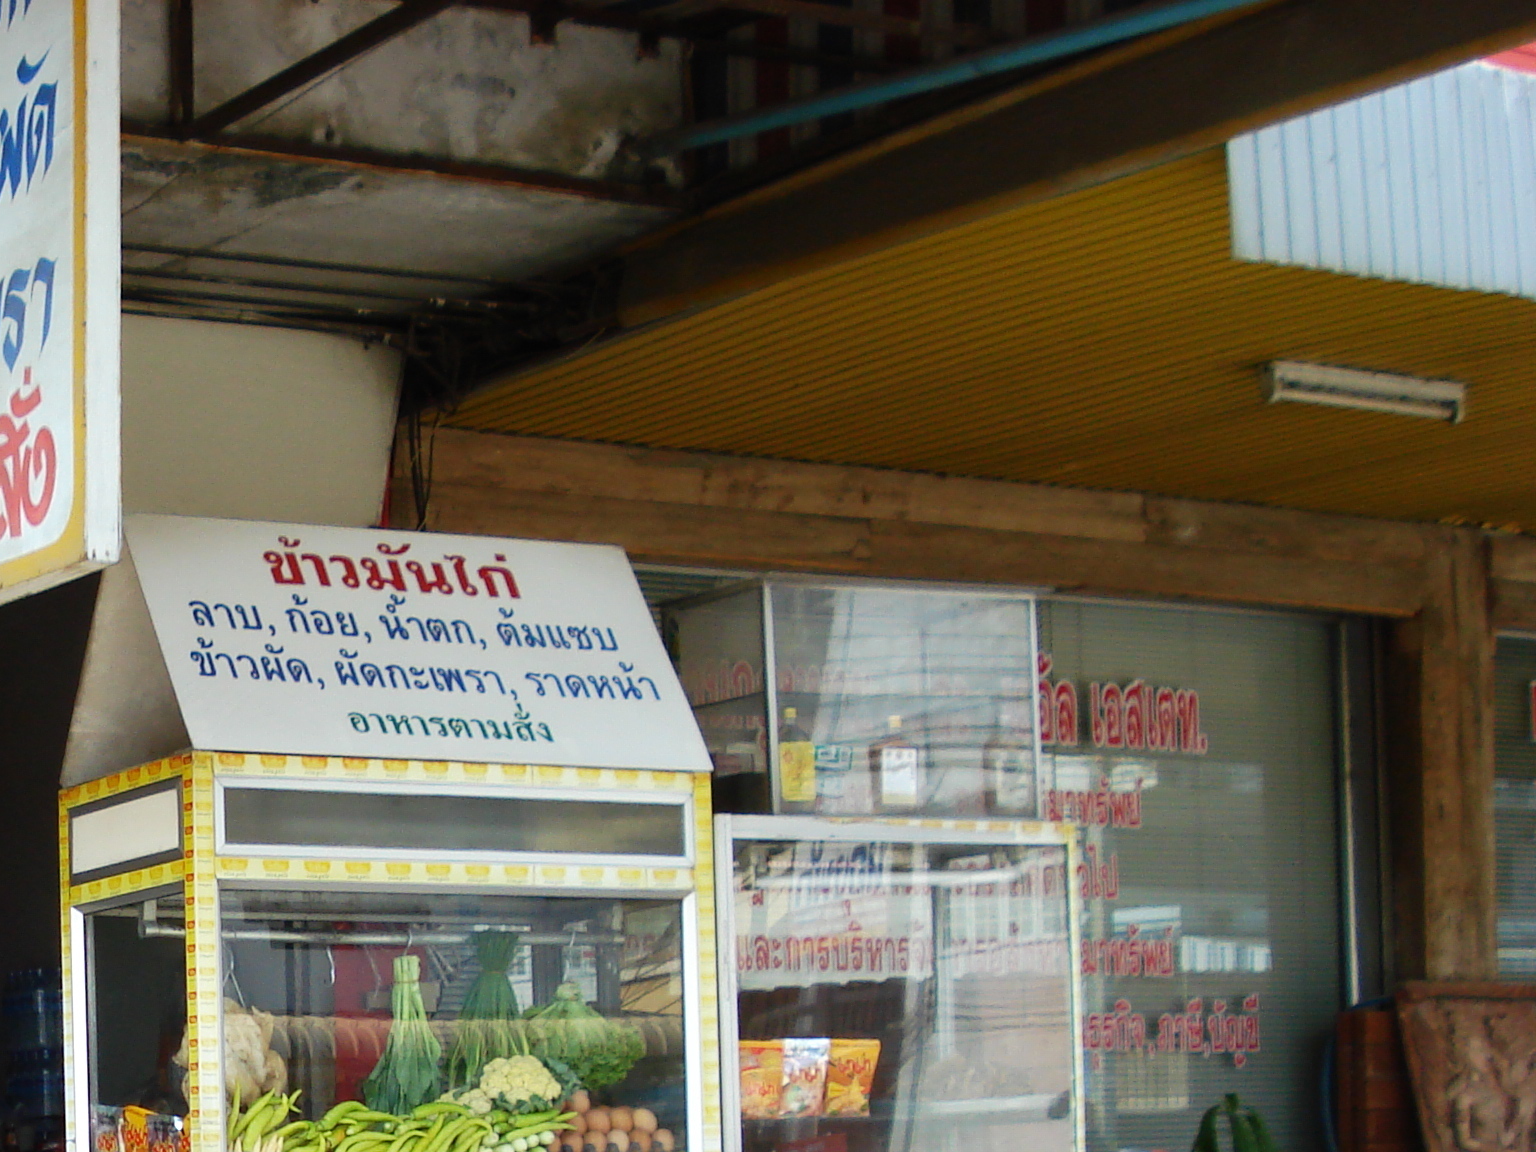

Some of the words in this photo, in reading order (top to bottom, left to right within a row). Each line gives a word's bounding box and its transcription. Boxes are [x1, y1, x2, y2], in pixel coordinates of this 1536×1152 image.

[263, 536, 521, 599] ข้าวมันไก่
[189, 599, 276, 637] ลาบ,
[285, 600, 371, 643] ก้อย,
[380, 594, 487, 650] น้ำตก,
[497, 606, 619, 653] ต้มแซบ
[190, 637, 324, 690] ข้าวผัด,
[335, 648, 519, 699] ผัดกะเพรา,
[525, 661, 661, 702] ราดหน้า
[350, 702, 554, 744] อาหารตามสั่ง
